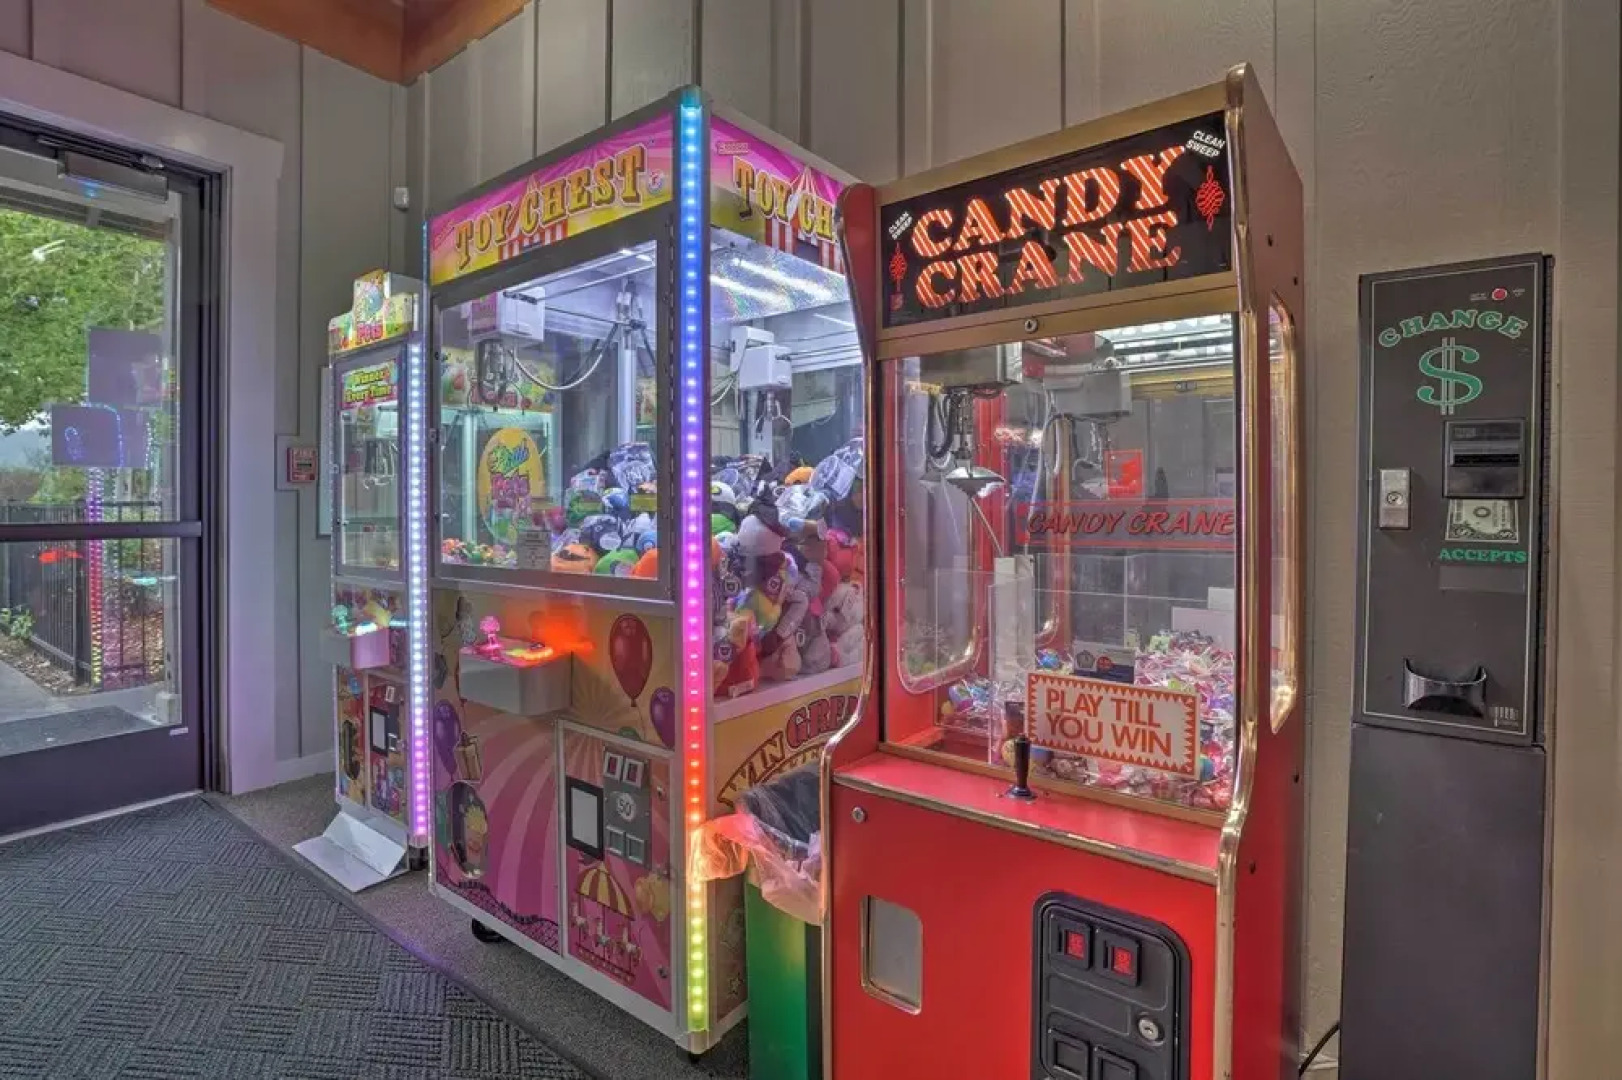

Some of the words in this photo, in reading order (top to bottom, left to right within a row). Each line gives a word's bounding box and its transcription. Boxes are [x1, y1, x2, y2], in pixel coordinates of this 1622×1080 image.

[1185, 139, 1221, 158] SWEEP
[1193, 130, 1226, 149] CLEAN
[455, 202, 513, 272] TOY
[519, 142, 648, 236] CHEST
[733, 155, 794, 226] TOY
[911, 145, 1185, 258] CANDY
[916, 211, 1182, 309] CRANE
[1379, 309, 1529, 348] CHANGE
[1028, 510, 1126, 535] CANDY
[1128, 509, 1235, 536] CRANE
[1440, 548, 1528, 563] ACCEPTS
[1046, 687, 1104, 718] PLAY
[1110, 697, 1161, 729] TILL
[1045, 711, 1104, 744] YOU
[1110, 723, 1172, 758] WIN
[716, 730, 787, 808] WIN
